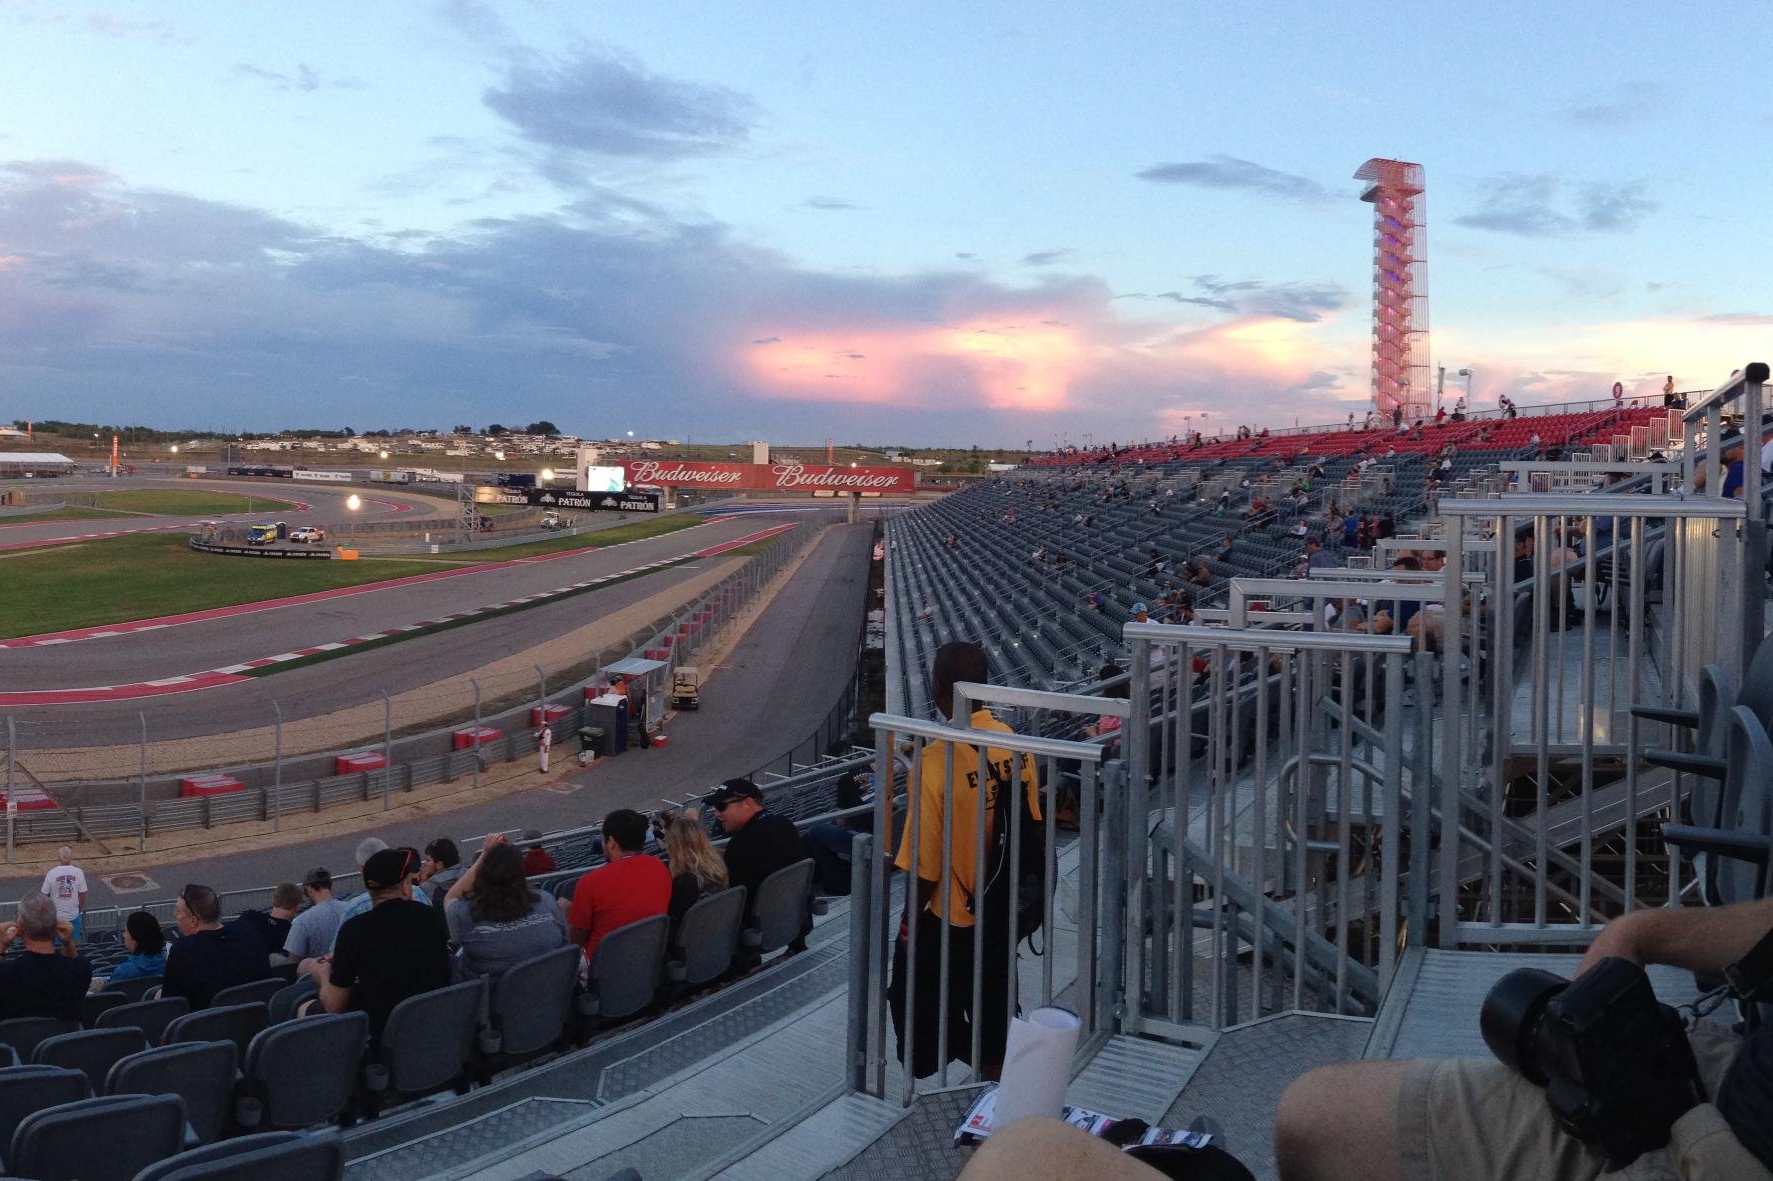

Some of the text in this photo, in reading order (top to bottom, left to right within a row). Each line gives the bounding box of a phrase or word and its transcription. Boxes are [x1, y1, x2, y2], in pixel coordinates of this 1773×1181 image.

[630, 461, 741, 483] Budweiser
[772, 464, 899, 488] Budweiser
[558, 497, 591, 507] PATRÓN
[620, 500, 655, 511] PATRÓN
